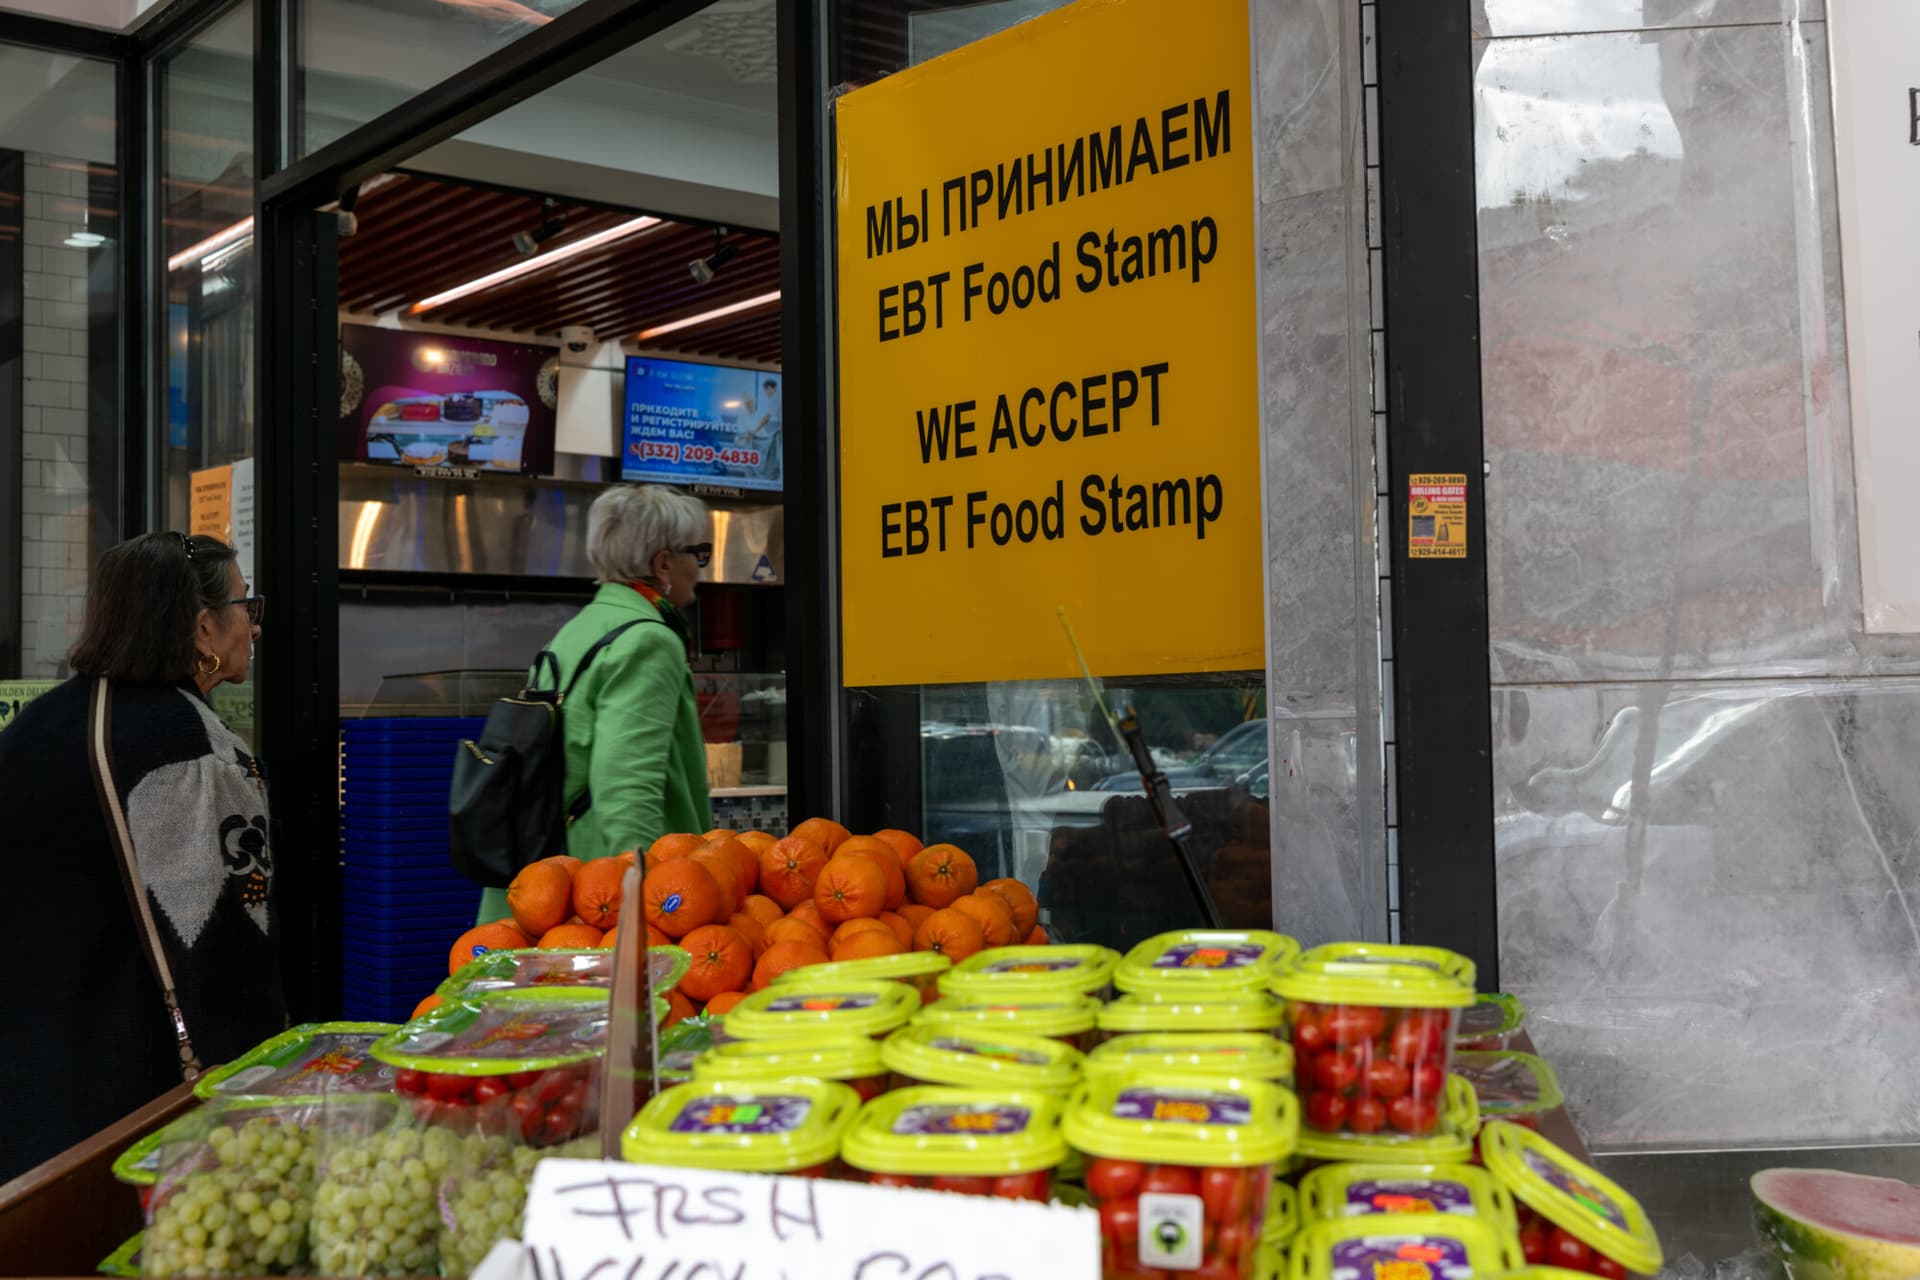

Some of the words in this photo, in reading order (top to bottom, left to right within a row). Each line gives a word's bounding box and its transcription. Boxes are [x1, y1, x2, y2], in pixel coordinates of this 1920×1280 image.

[867, 188, 928, 259] МЫ
[943, 89, 1231, 237] ПРИНИМАЕМ
[878, 271, 951, 343] EBT
[963, 241, 1061, 322] Food
[1075, 214, 1218, 294] Stamp
[631, 402, 699, 418] ПРИХОДИТЕ
[640, 442, 680, 463] (332)
[684, 445, 760, 466] 209-4838
[916, 399, 978, 465] WE
[988, 361, 1169, 454] ACCEPT
[881, 496, 954, 559] EBT
[966, 479, 1065, 549] Food
[1079, 473, 1223, 540] Stamp
